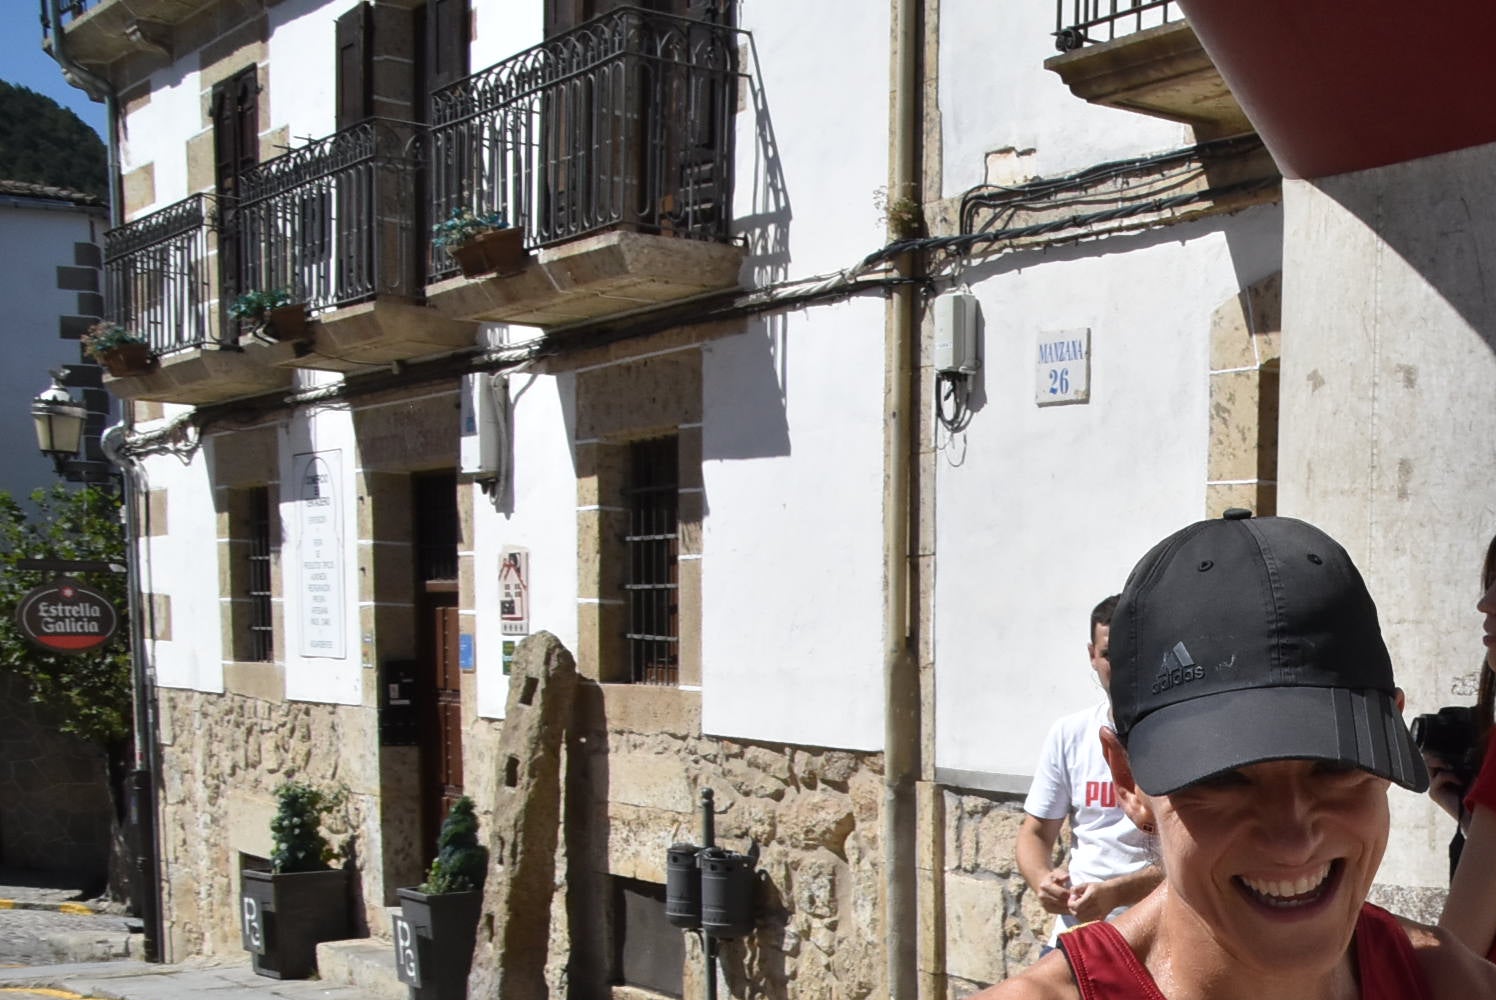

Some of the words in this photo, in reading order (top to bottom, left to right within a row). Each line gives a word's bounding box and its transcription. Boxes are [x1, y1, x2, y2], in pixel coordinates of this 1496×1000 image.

[1039, 338, 1085, 364] MANZANA
[1049, 367, 1070, 395] 26
[38, 602, 100, 618] Estrella
[41, 617, 99, 633] Galicia
[1152, 665, 1206, 695] adidas
[1085, 781, 1117, 808] PU
